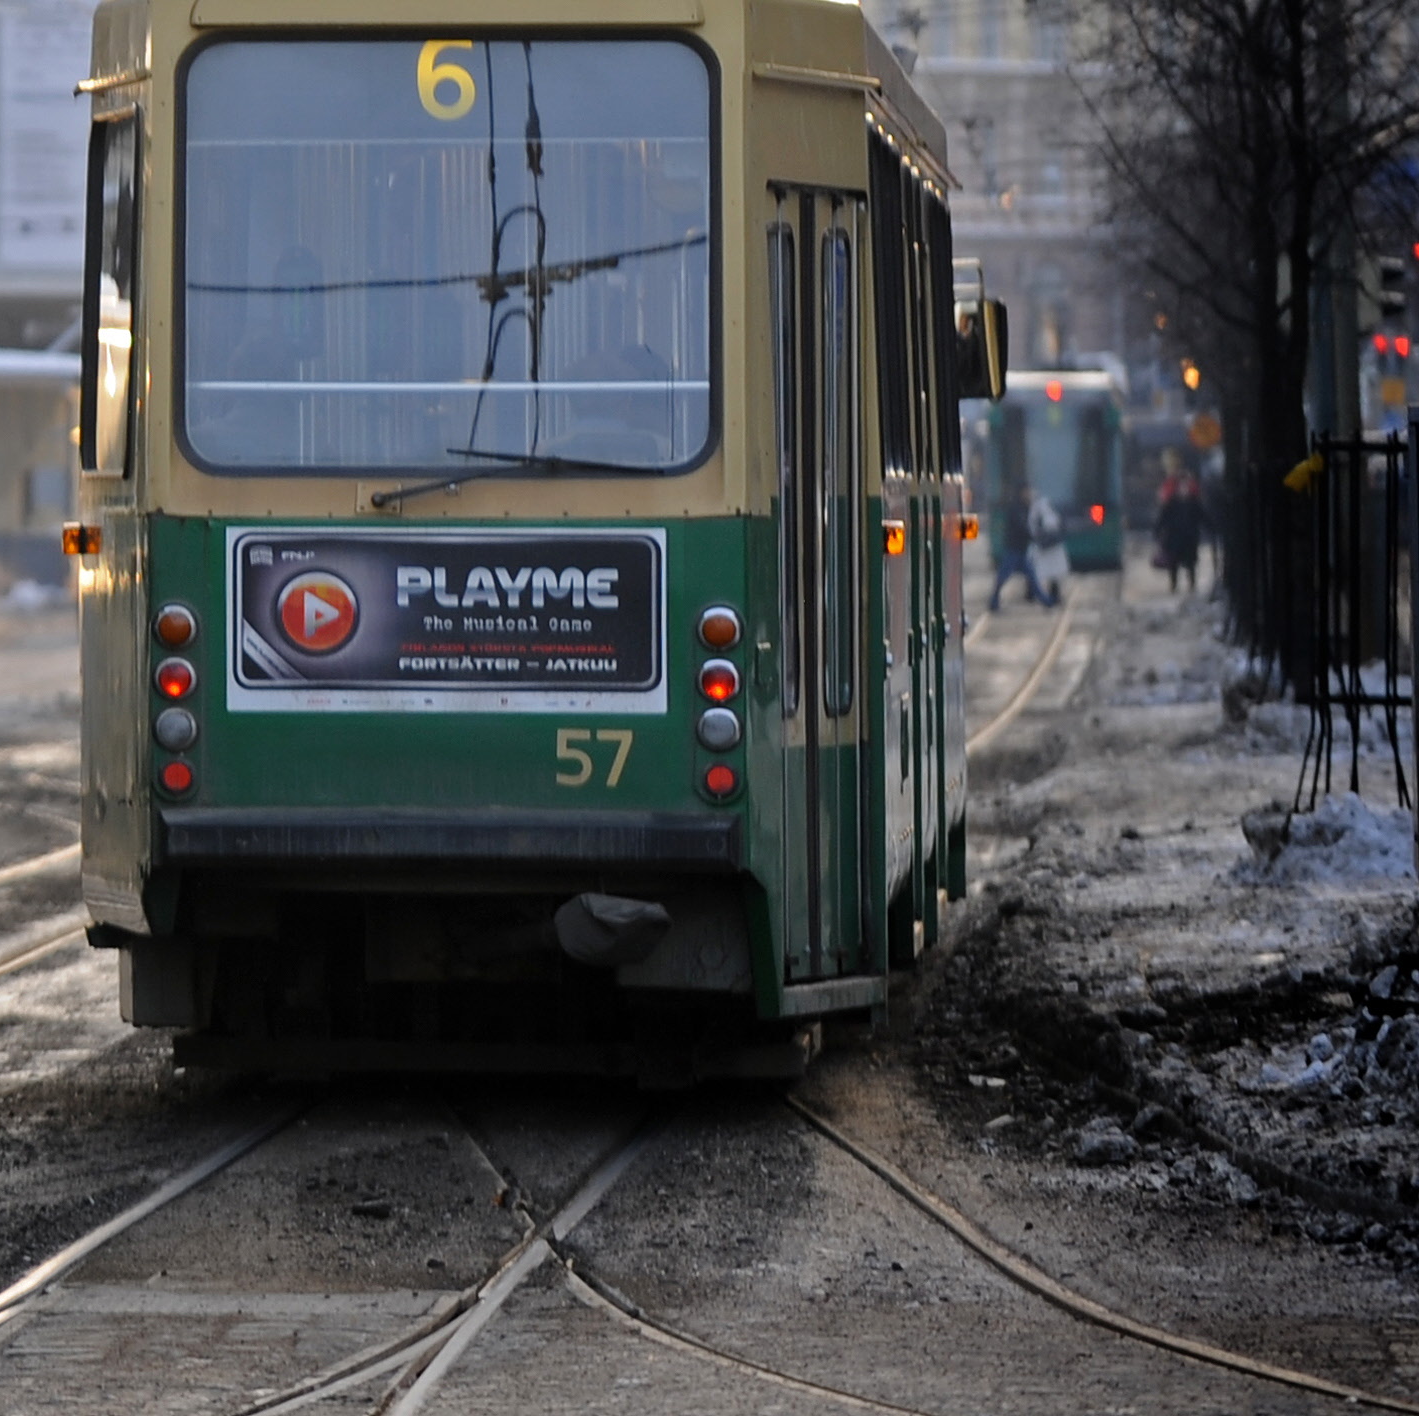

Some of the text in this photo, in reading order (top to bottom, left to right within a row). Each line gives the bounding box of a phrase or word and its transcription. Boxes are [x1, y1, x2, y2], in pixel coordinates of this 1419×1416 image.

[417, 39, 476, 121] 6
[396, 565, 620, 609] PLAYME
[423, 615, 593, 633] The Musical Game
[545, 657, 618, 672] JATKUU
[556, 728, 634, 787] 57
